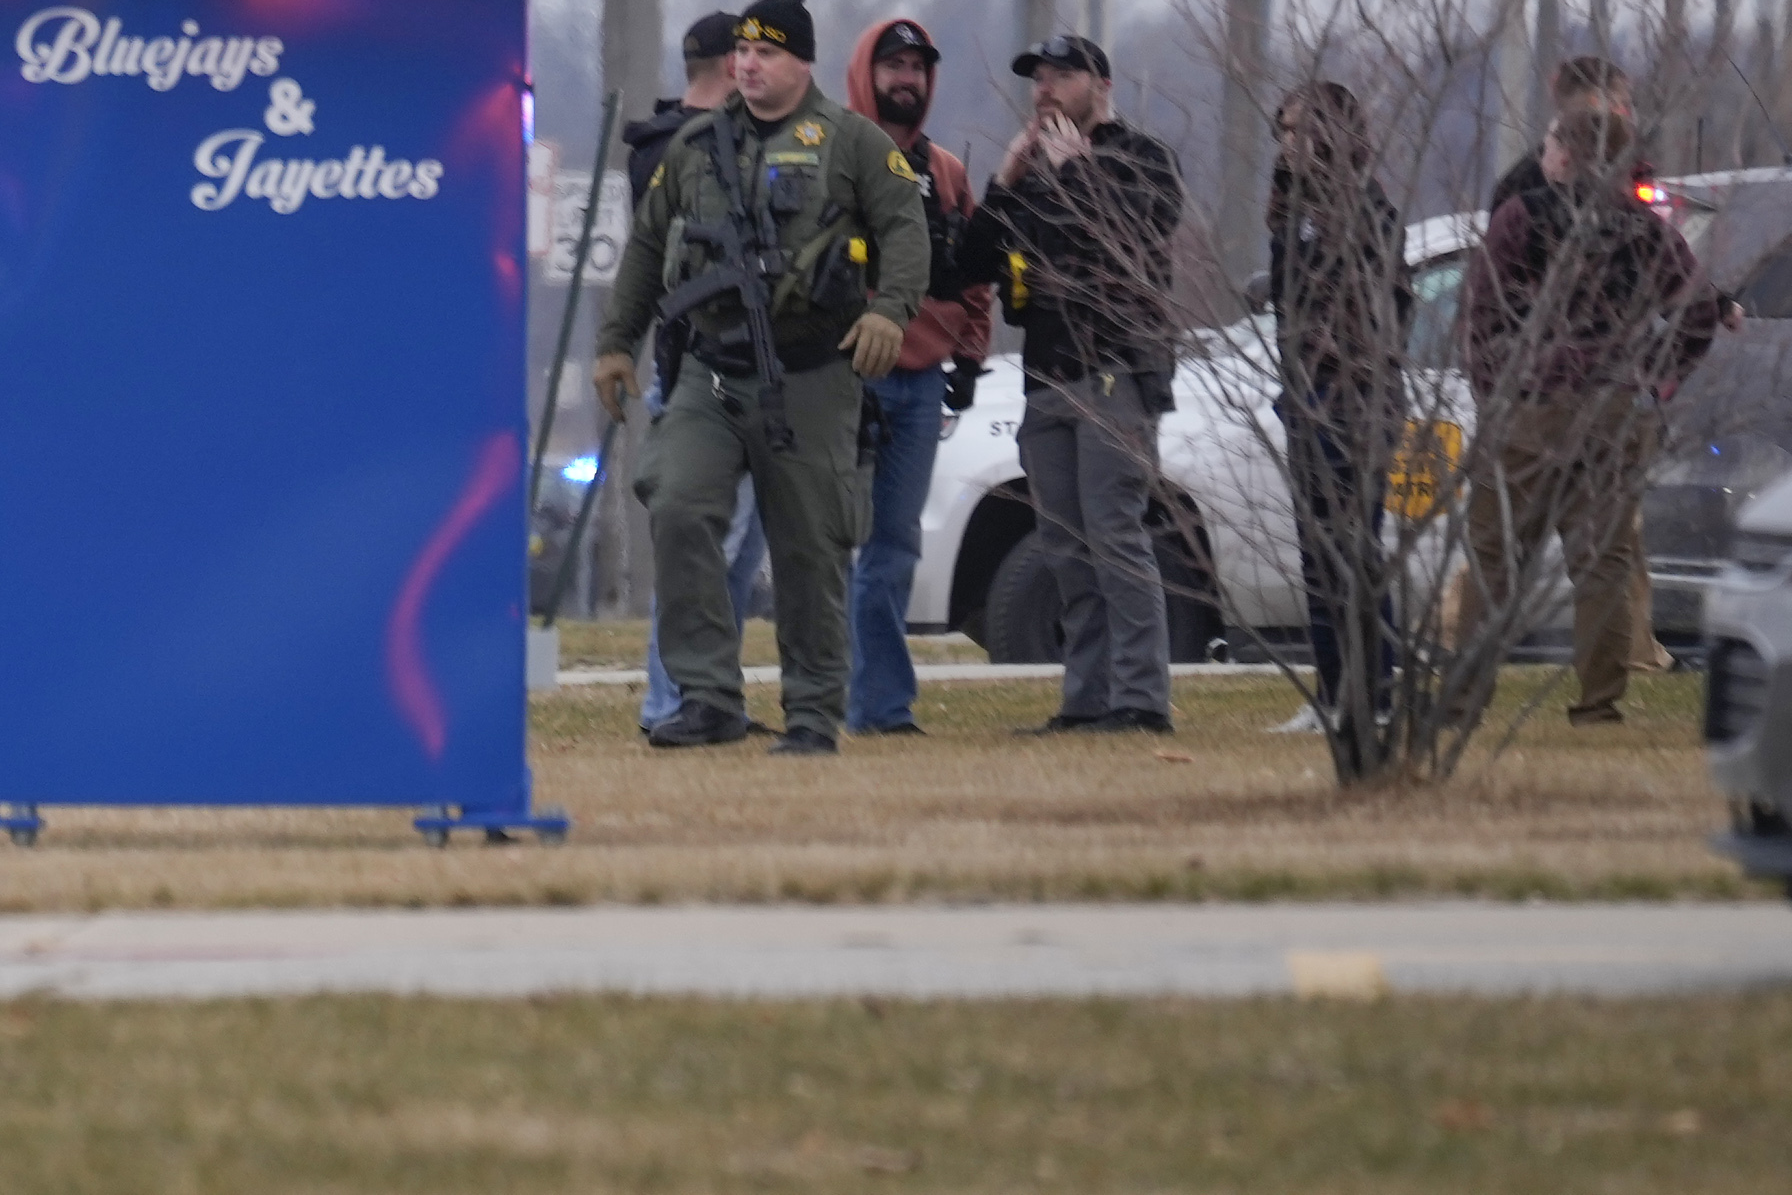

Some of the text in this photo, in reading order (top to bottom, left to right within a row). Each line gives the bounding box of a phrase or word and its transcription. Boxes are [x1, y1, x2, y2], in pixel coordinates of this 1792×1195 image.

[15, 6, 284, 93] Bluejays
[264, 78, 316, 136] &
[189, 127, 444, 215] Jayettes
[555, 233, 618, 272] 30
